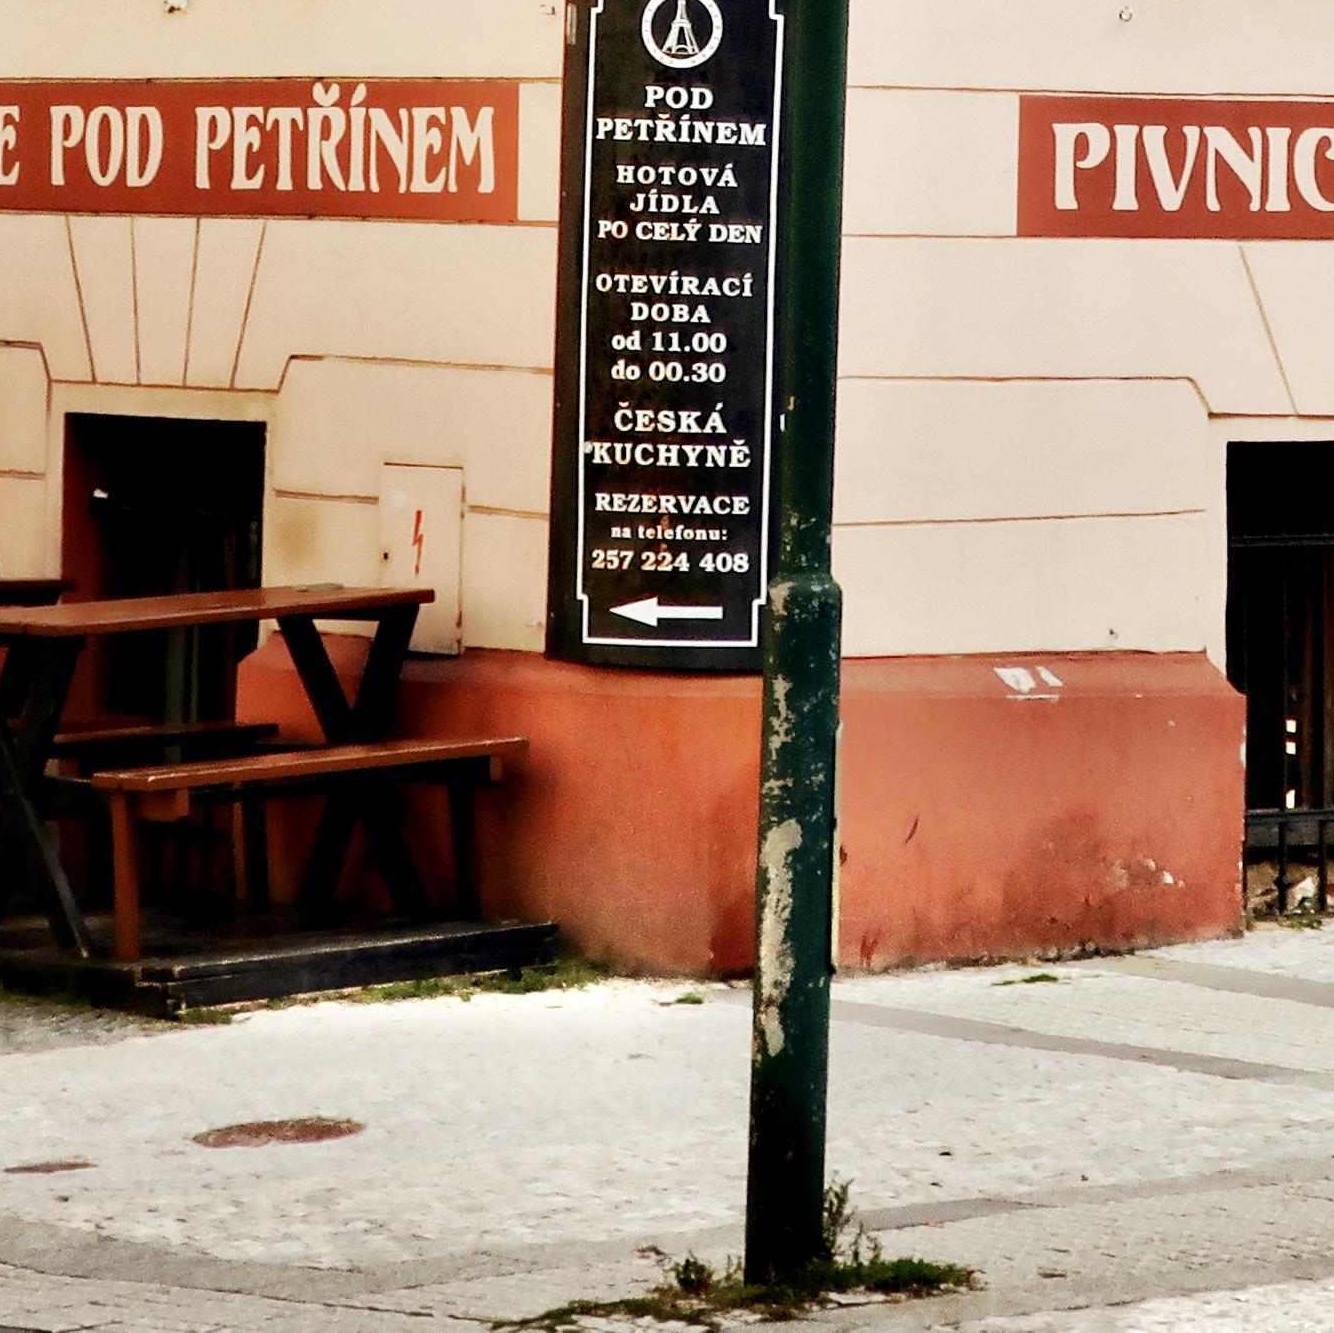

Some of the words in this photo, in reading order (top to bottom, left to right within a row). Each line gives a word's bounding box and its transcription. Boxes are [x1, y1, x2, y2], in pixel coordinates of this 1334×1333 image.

[644, 86, 713, 109] POD
[49, 105, 164, 188] POD
[195, 82, 495, 193] PETŘÍNEM
[596, 113, 766, 145] PETŘÍNEM
[616, 162, 738, 187] HOTOVÁ
[630, 189, 720, 214] JÍDLA
[598, 220, 628, 239] PO
[635, 218, 702, 242] CELÝ
[708, 224, 763, 244] DEN
[595, 270, 753, 297] OTEVÍRACÍ
[630, 302, 711, 323] DOBA
[611, 330, 641, 351] od
[652, 332, 727, 353] 11.00
[611, 359, 641, 380] do
[648, 361, 726, 382] 00.30
[614, 401, 727, 434] ČESKÁ
[592, 439, 751, 468] KUCHYNĚ
[595, 493, 750, 514] REZERVACE
[611, 526, 632, 539] na
[638, 525, 728, 540] telefonu:
[591, 549, 634, 569] 257
[641, 552, 690, 572] 224
[699, 553, 749, 573] 408
